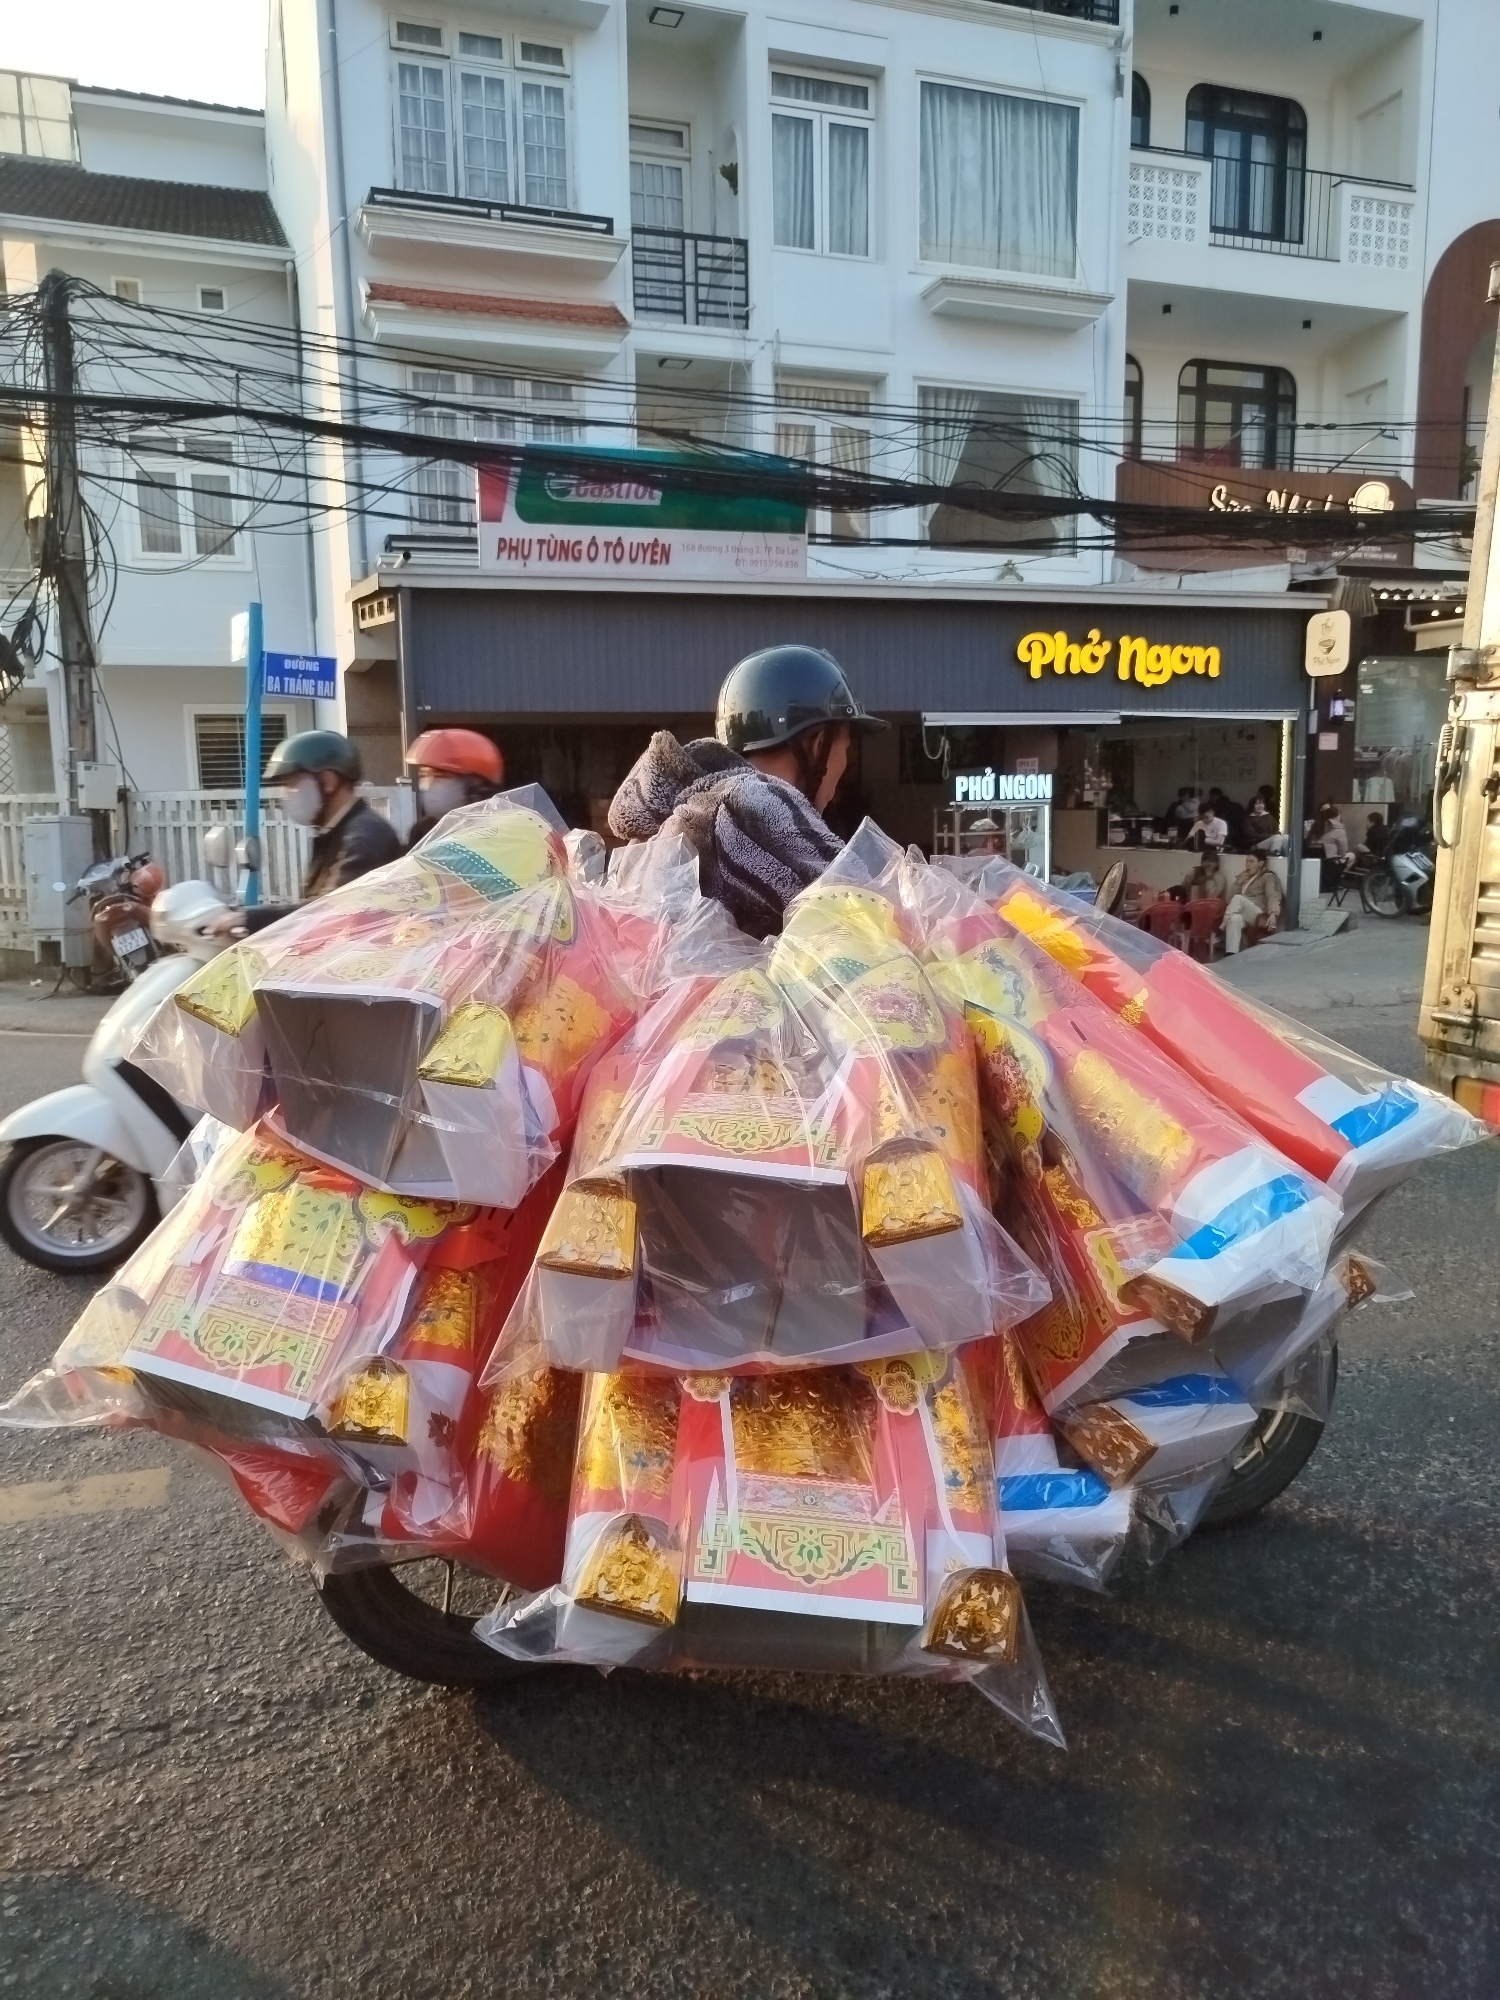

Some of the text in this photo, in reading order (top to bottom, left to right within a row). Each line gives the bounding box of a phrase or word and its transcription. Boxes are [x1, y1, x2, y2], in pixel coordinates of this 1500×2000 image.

[497, 534, 671, 568] PHỤ TÙNG Ô TÔ UYÊN
[682, 543, 695, 552] 168
[725, 545, 729, 553] 3
[284, 656, 320, 671] ĐƯỜNG
[1017, 628, 1220, 687] Phở Ngon
[267, 673, 334, 697] BA THÁNG HAI
[955, 766, 1052, 801] PHỞ NGON
